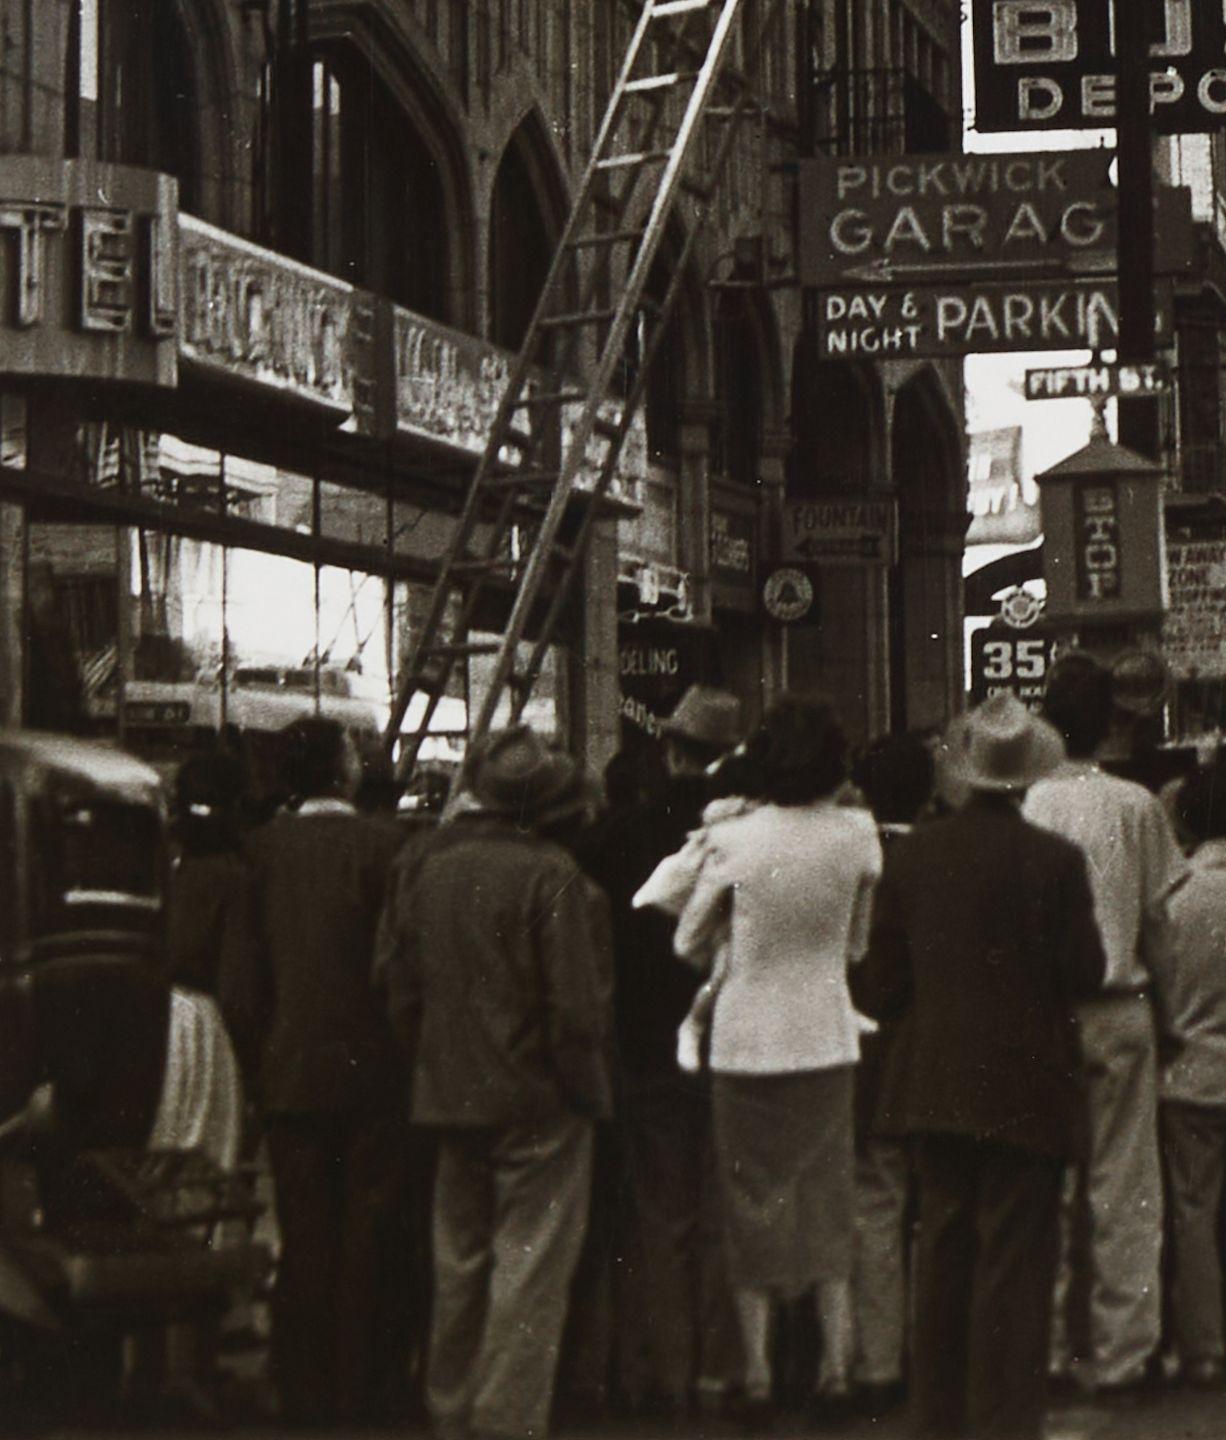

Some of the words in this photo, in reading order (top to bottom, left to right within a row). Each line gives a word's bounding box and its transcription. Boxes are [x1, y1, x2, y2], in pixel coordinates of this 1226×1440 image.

[836, 160, 1067, 199] PICKWICK
[830, 201, 1105, 255] GARAG
[826, 294, 887, 320] DAY
[900, 292, 919, 319] &
[936, 291, 1119, 343] PARKIN
[827, 325, 922, 353] NIGHT
[1030, 367, 1110, 394] FIFTH
